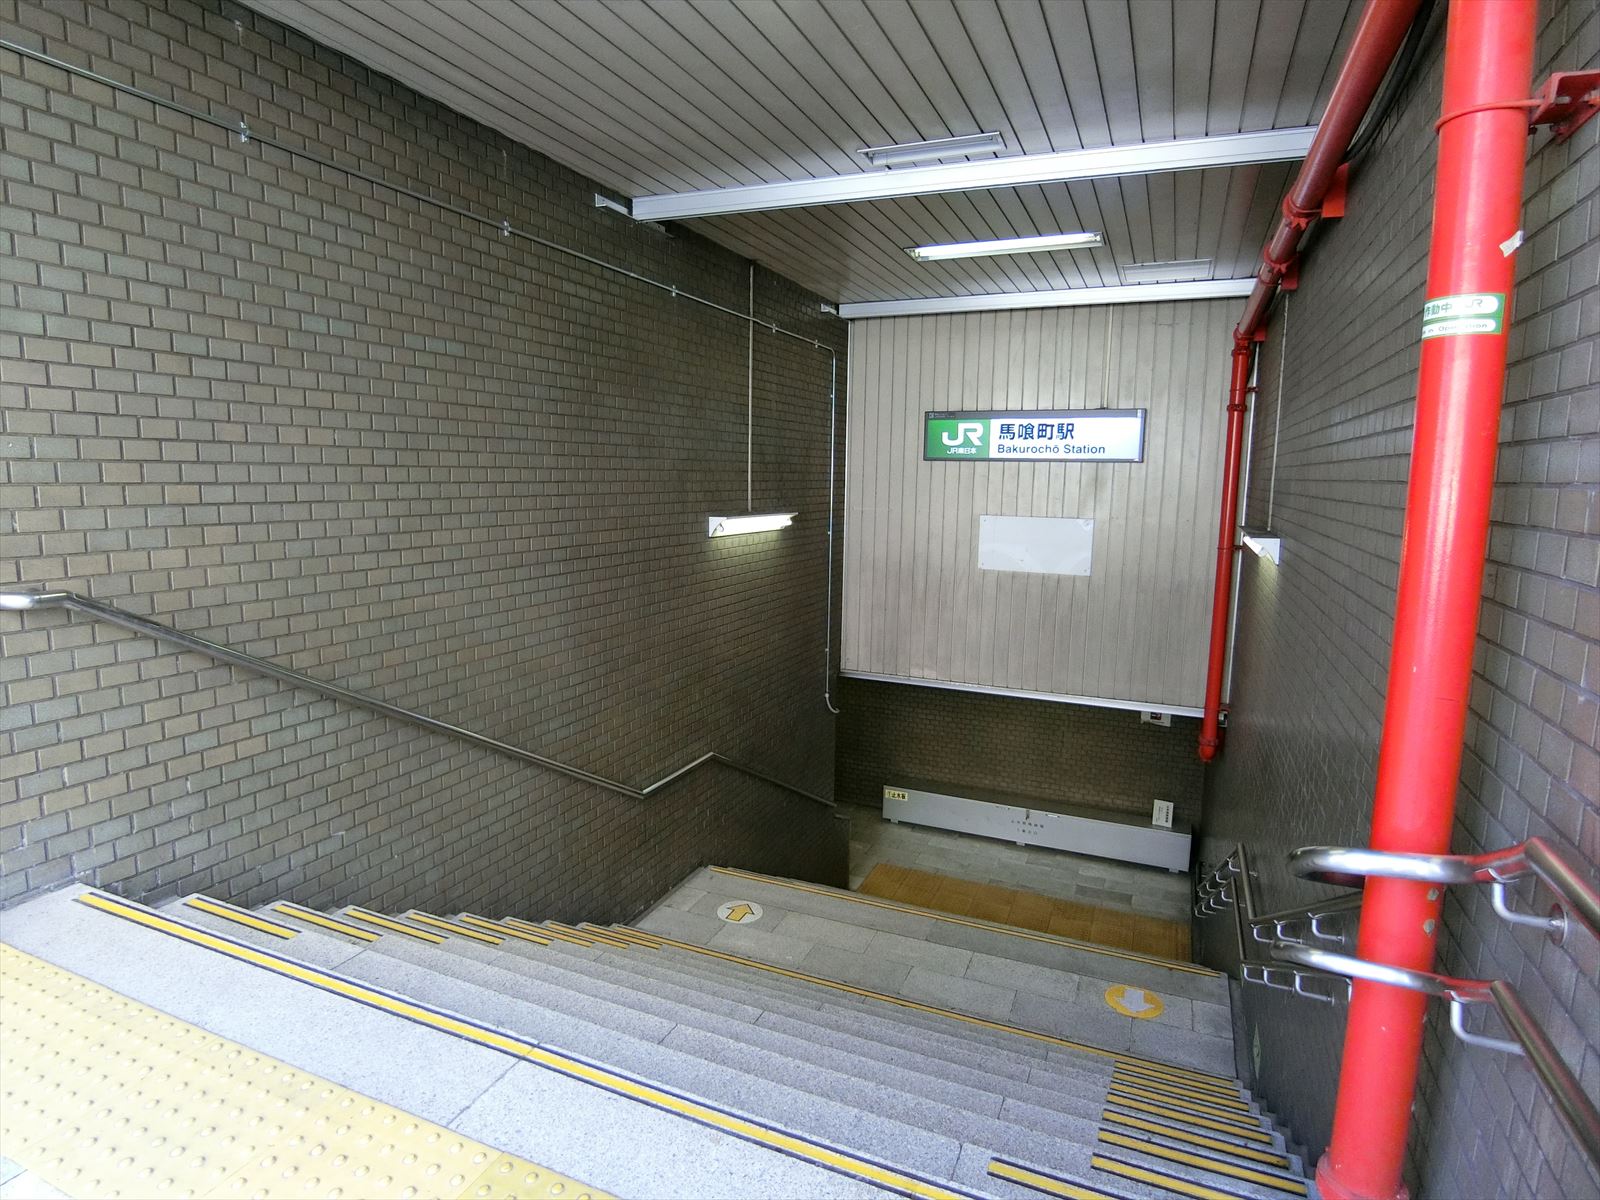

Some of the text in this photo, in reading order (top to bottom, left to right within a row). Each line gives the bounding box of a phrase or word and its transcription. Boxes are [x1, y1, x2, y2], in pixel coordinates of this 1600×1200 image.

[942, 422, 984, 446] JR
[999, 422, 1075, 440] 馬喰町駅
[997, 443, 1106, 454] Bakurochō Station
